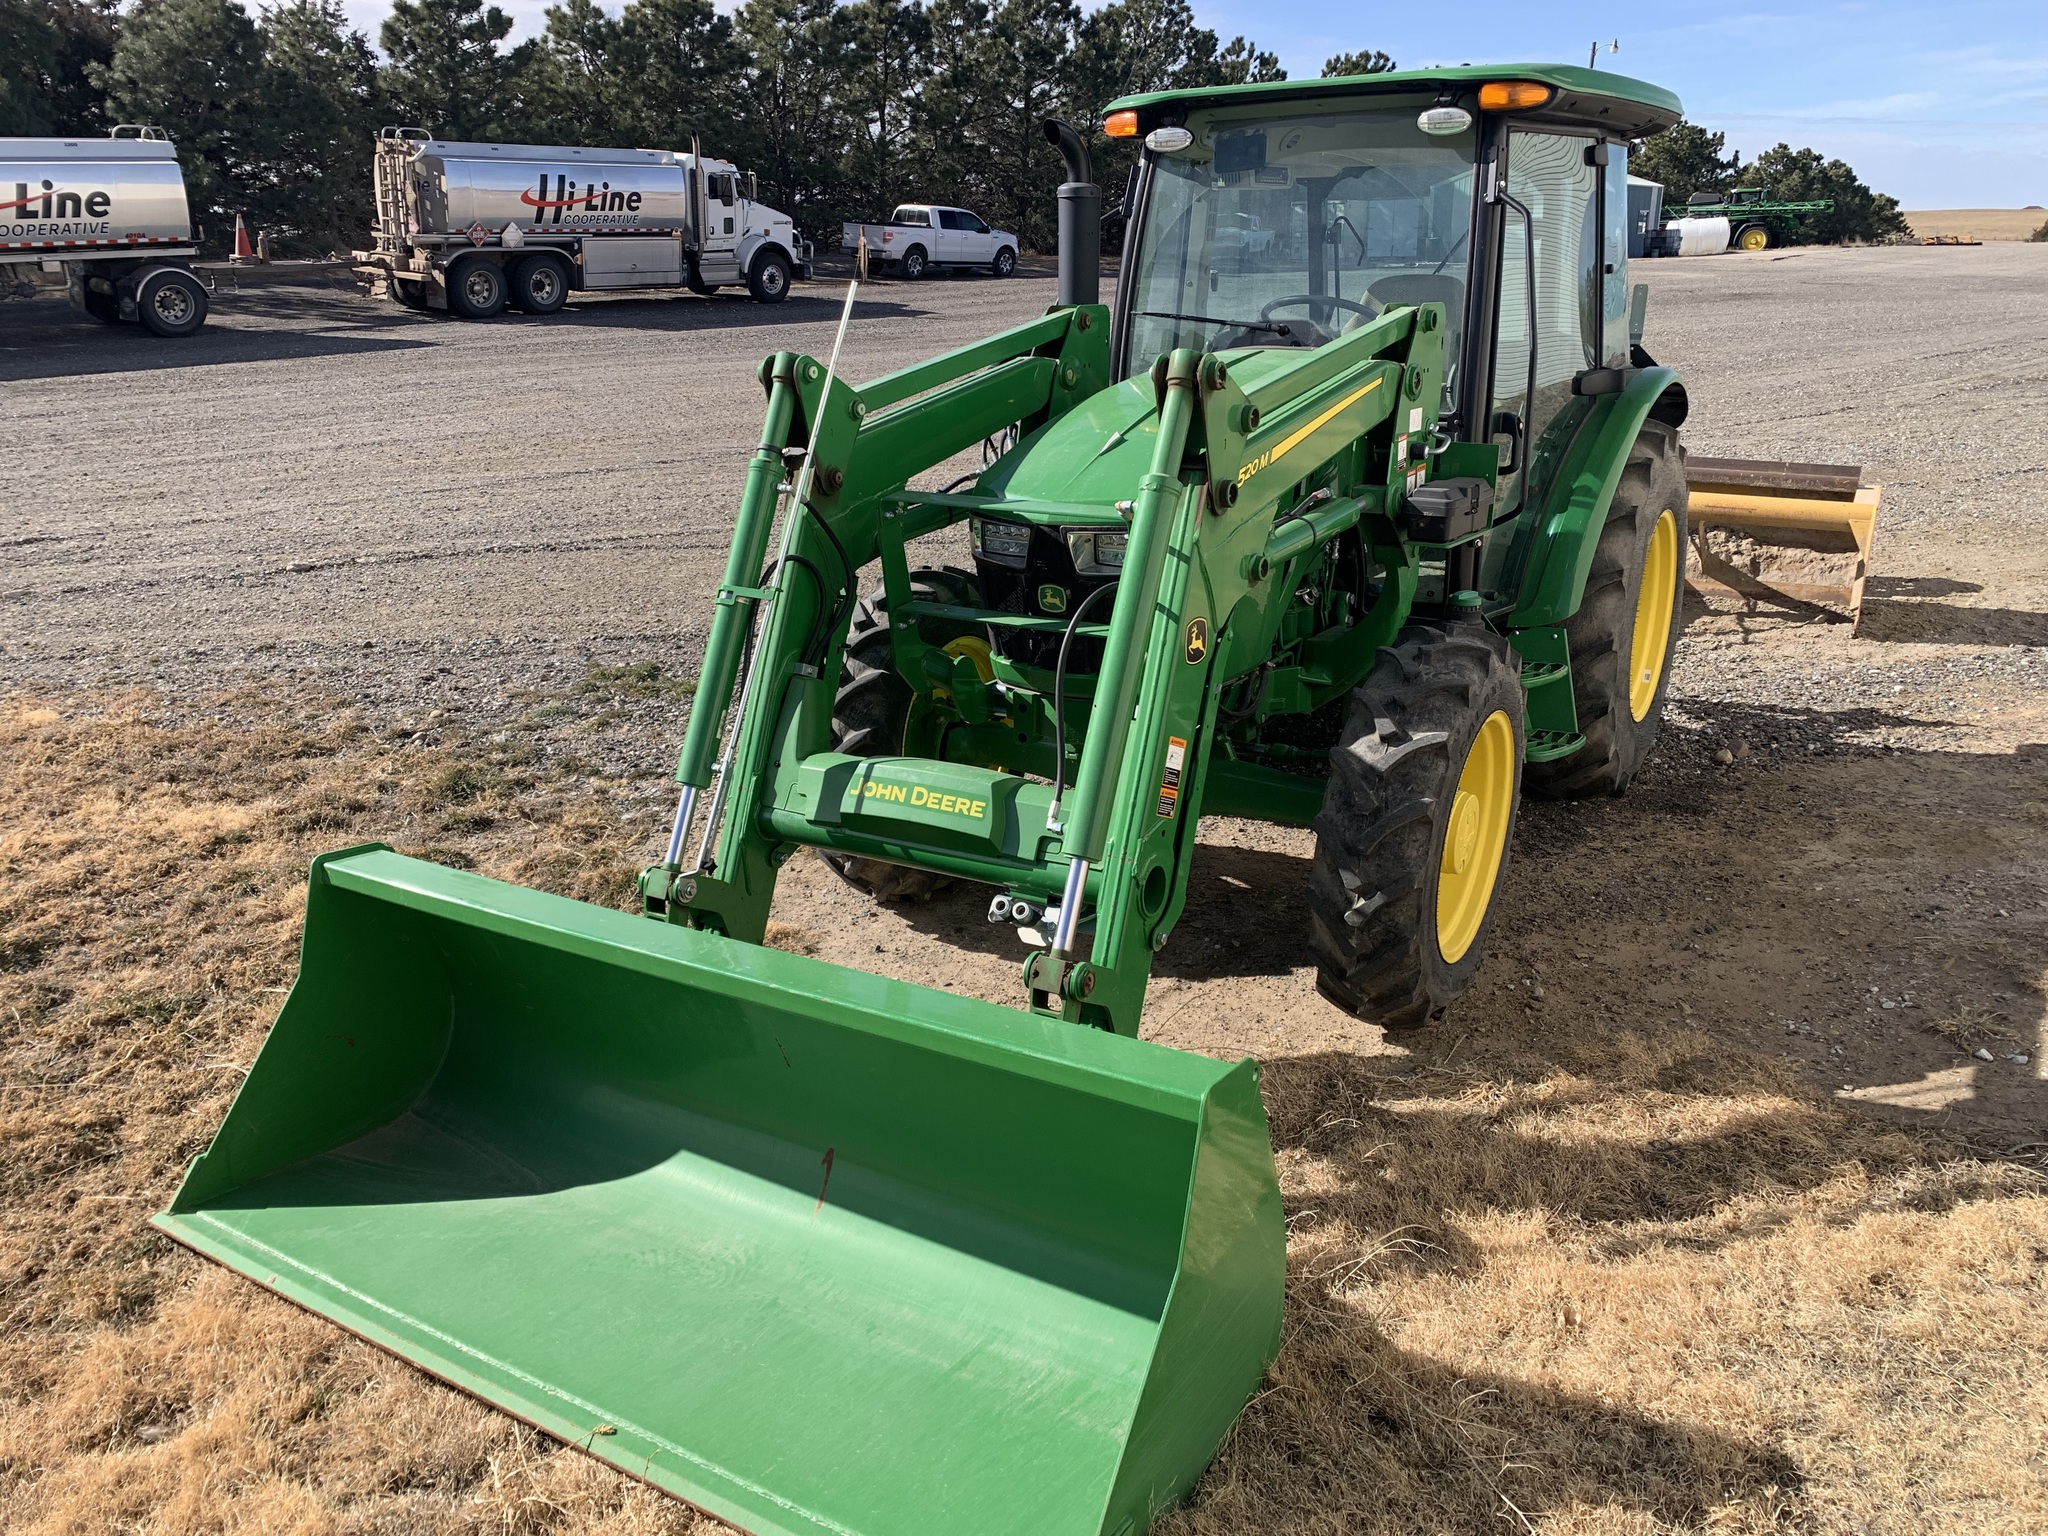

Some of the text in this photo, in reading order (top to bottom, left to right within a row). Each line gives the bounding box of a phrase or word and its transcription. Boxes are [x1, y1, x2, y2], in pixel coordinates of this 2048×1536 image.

[15, 179, 111, 219] Line
[534, 174, 642, 224] Hi Line
[564, 214, 640, 225] COOPERATIVE
[850, 777, 987, 818] JOHN DEERE
